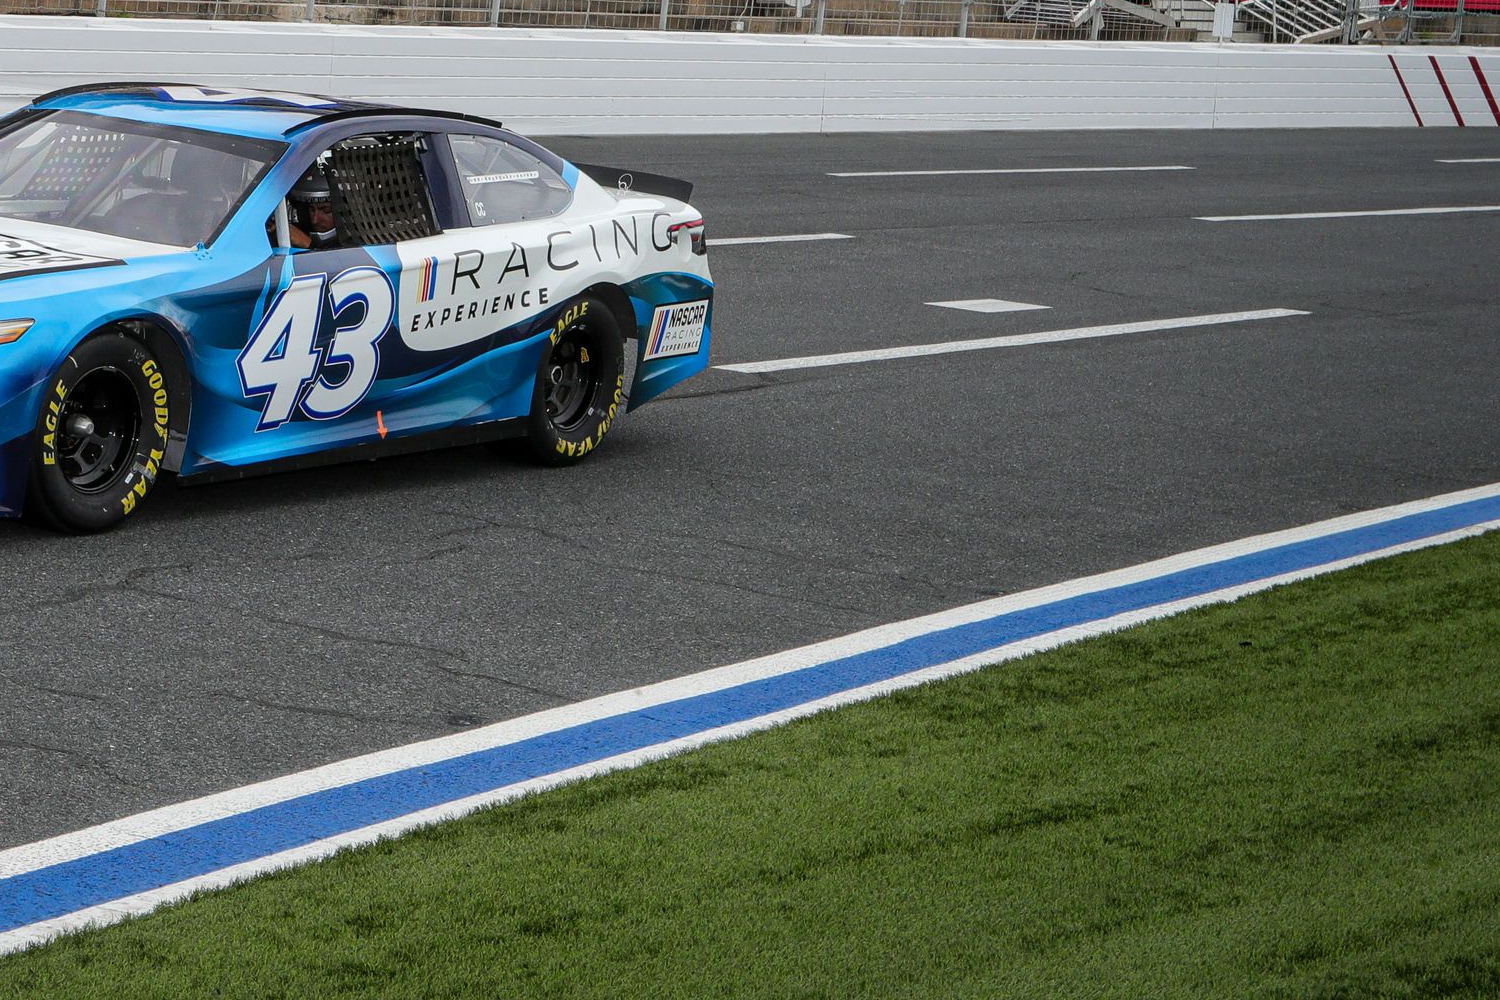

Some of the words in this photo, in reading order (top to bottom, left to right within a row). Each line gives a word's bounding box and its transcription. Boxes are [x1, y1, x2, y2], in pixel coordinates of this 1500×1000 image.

[451, 213, 672, 295] RACING
[410, 287, 549, 333] EXPERIENCE
[549, 301, 589, 346] EAGLE
[668, 304, 706, 328] NASCAR
[235, 265, 396, 433] 43
[660, 340, 699, 353] EXPERIENCE
[664, 327, 702, 341] RACING
[43, 379, 68, 465] EAGLE
